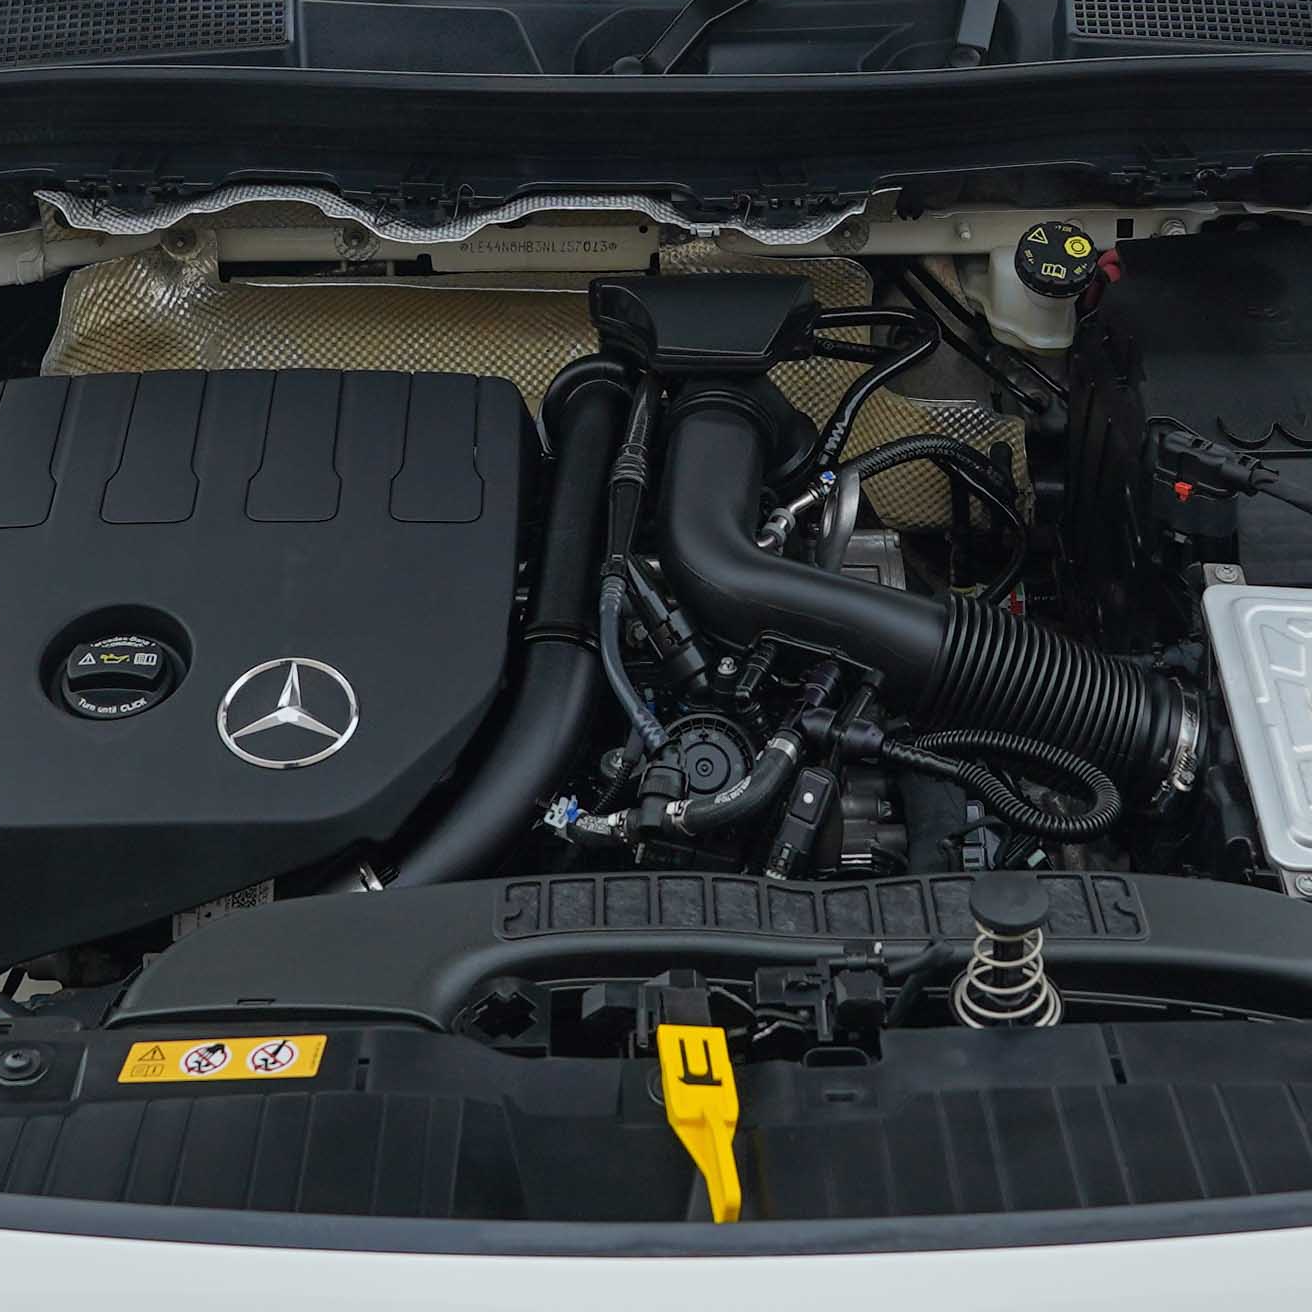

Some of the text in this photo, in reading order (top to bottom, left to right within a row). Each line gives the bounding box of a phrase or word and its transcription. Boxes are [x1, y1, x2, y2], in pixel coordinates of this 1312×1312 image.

[78, 697, 148, 714] Turn until CLICK
